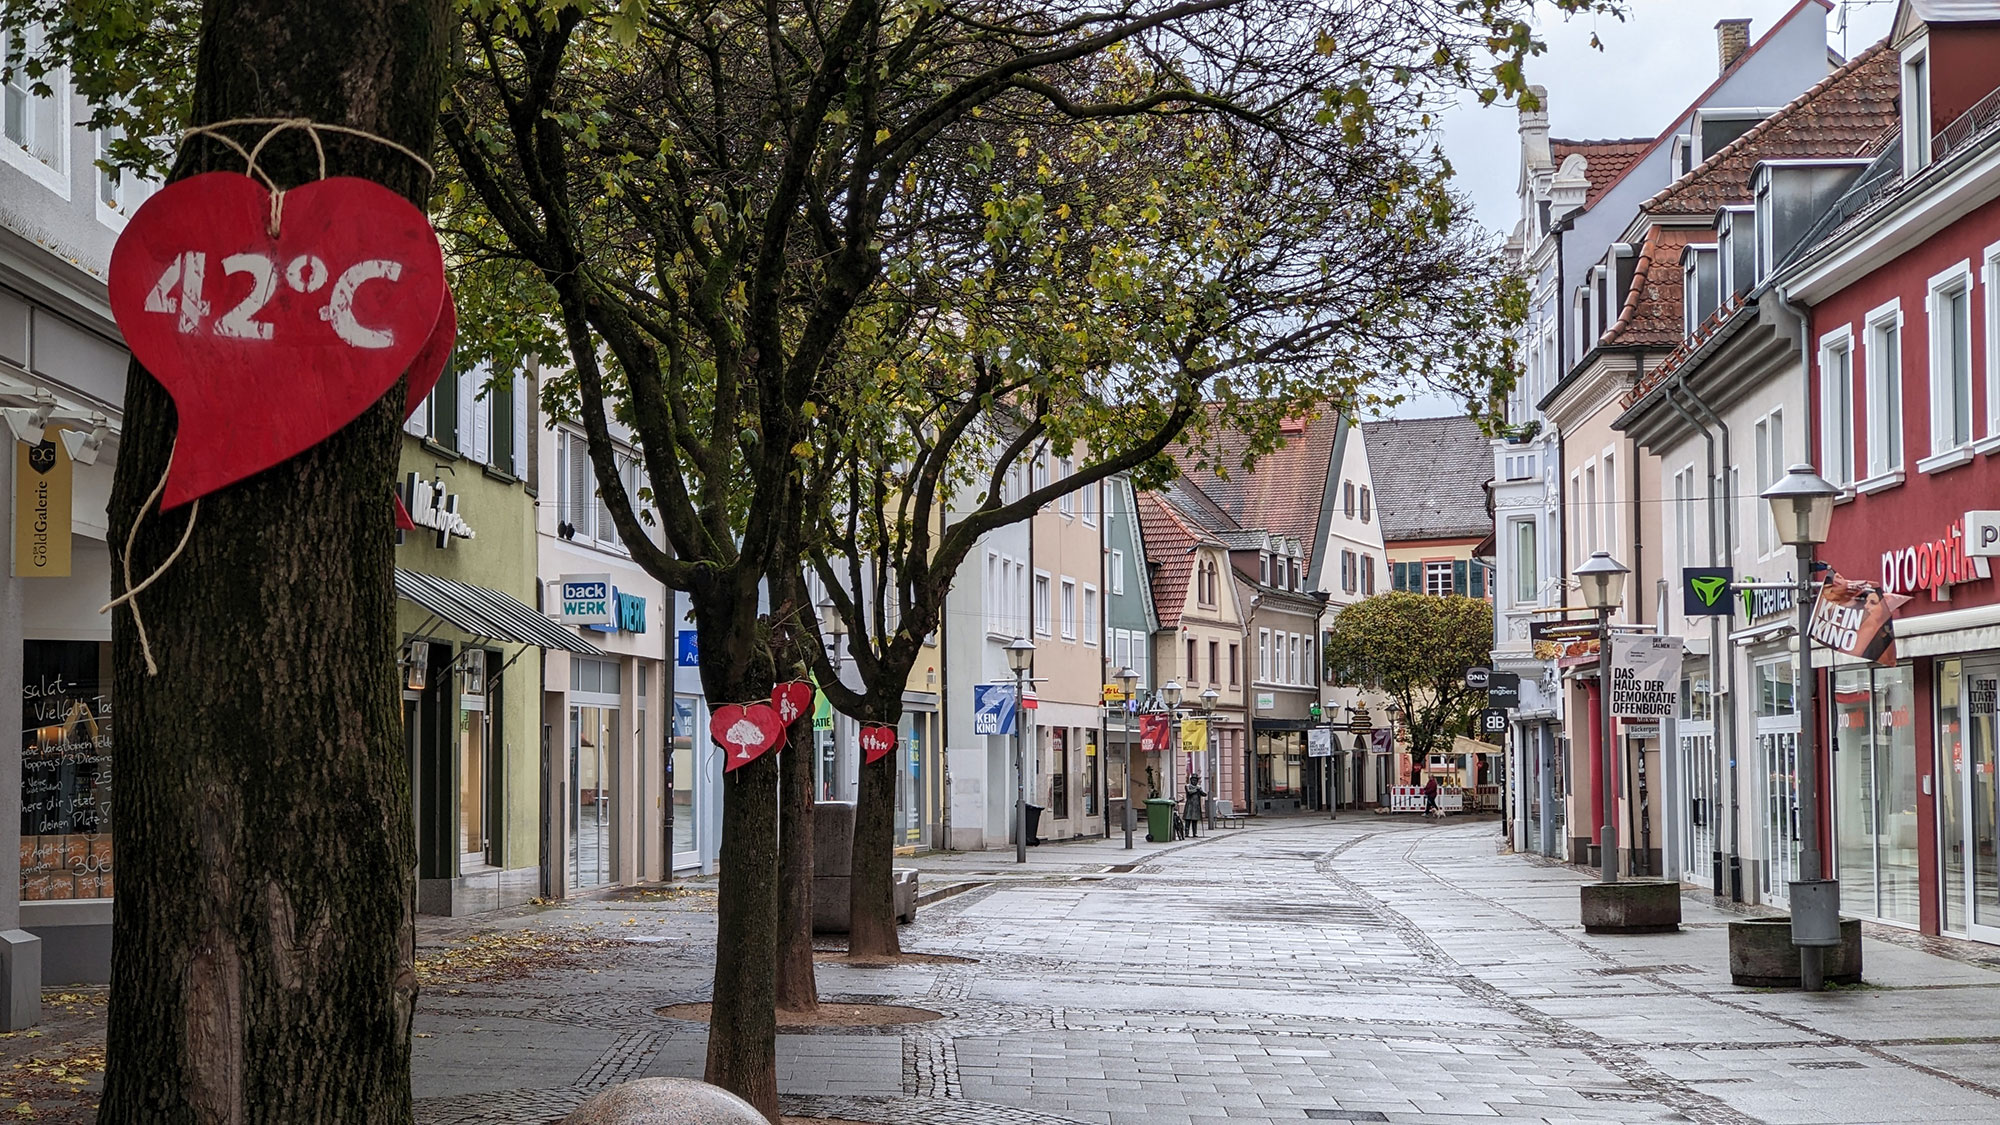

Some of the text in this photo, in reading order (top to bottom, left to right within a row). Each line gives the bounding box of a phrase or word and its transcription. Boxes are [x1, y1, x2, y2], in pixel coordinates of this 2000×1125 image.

[565, 584, 605, 598] back
[563, 601, 607, 616] WERK
[619, 593, 646, 633] WERK
[1819, 598, 1864, 630] KEIN
[1811, 617, 1858, 651] KINO
[1614, 667, 1635, 679] DAS
[1489, 688, 1517, 696] engbers
[1613, 679, 1664, 692] HAUS DER
[1613, 690, 1677, 704] DEMOKRATIE
[34, 698, 88, 721] Vielfalt
[1612, 702, 1671, 715] OFFENBURG
[977, 713, 997, 723] KEIN
[976, 723, 997, 734] KINO
[46, 796, 64, 811] dir
[40, 814, 69, 833] deinen
